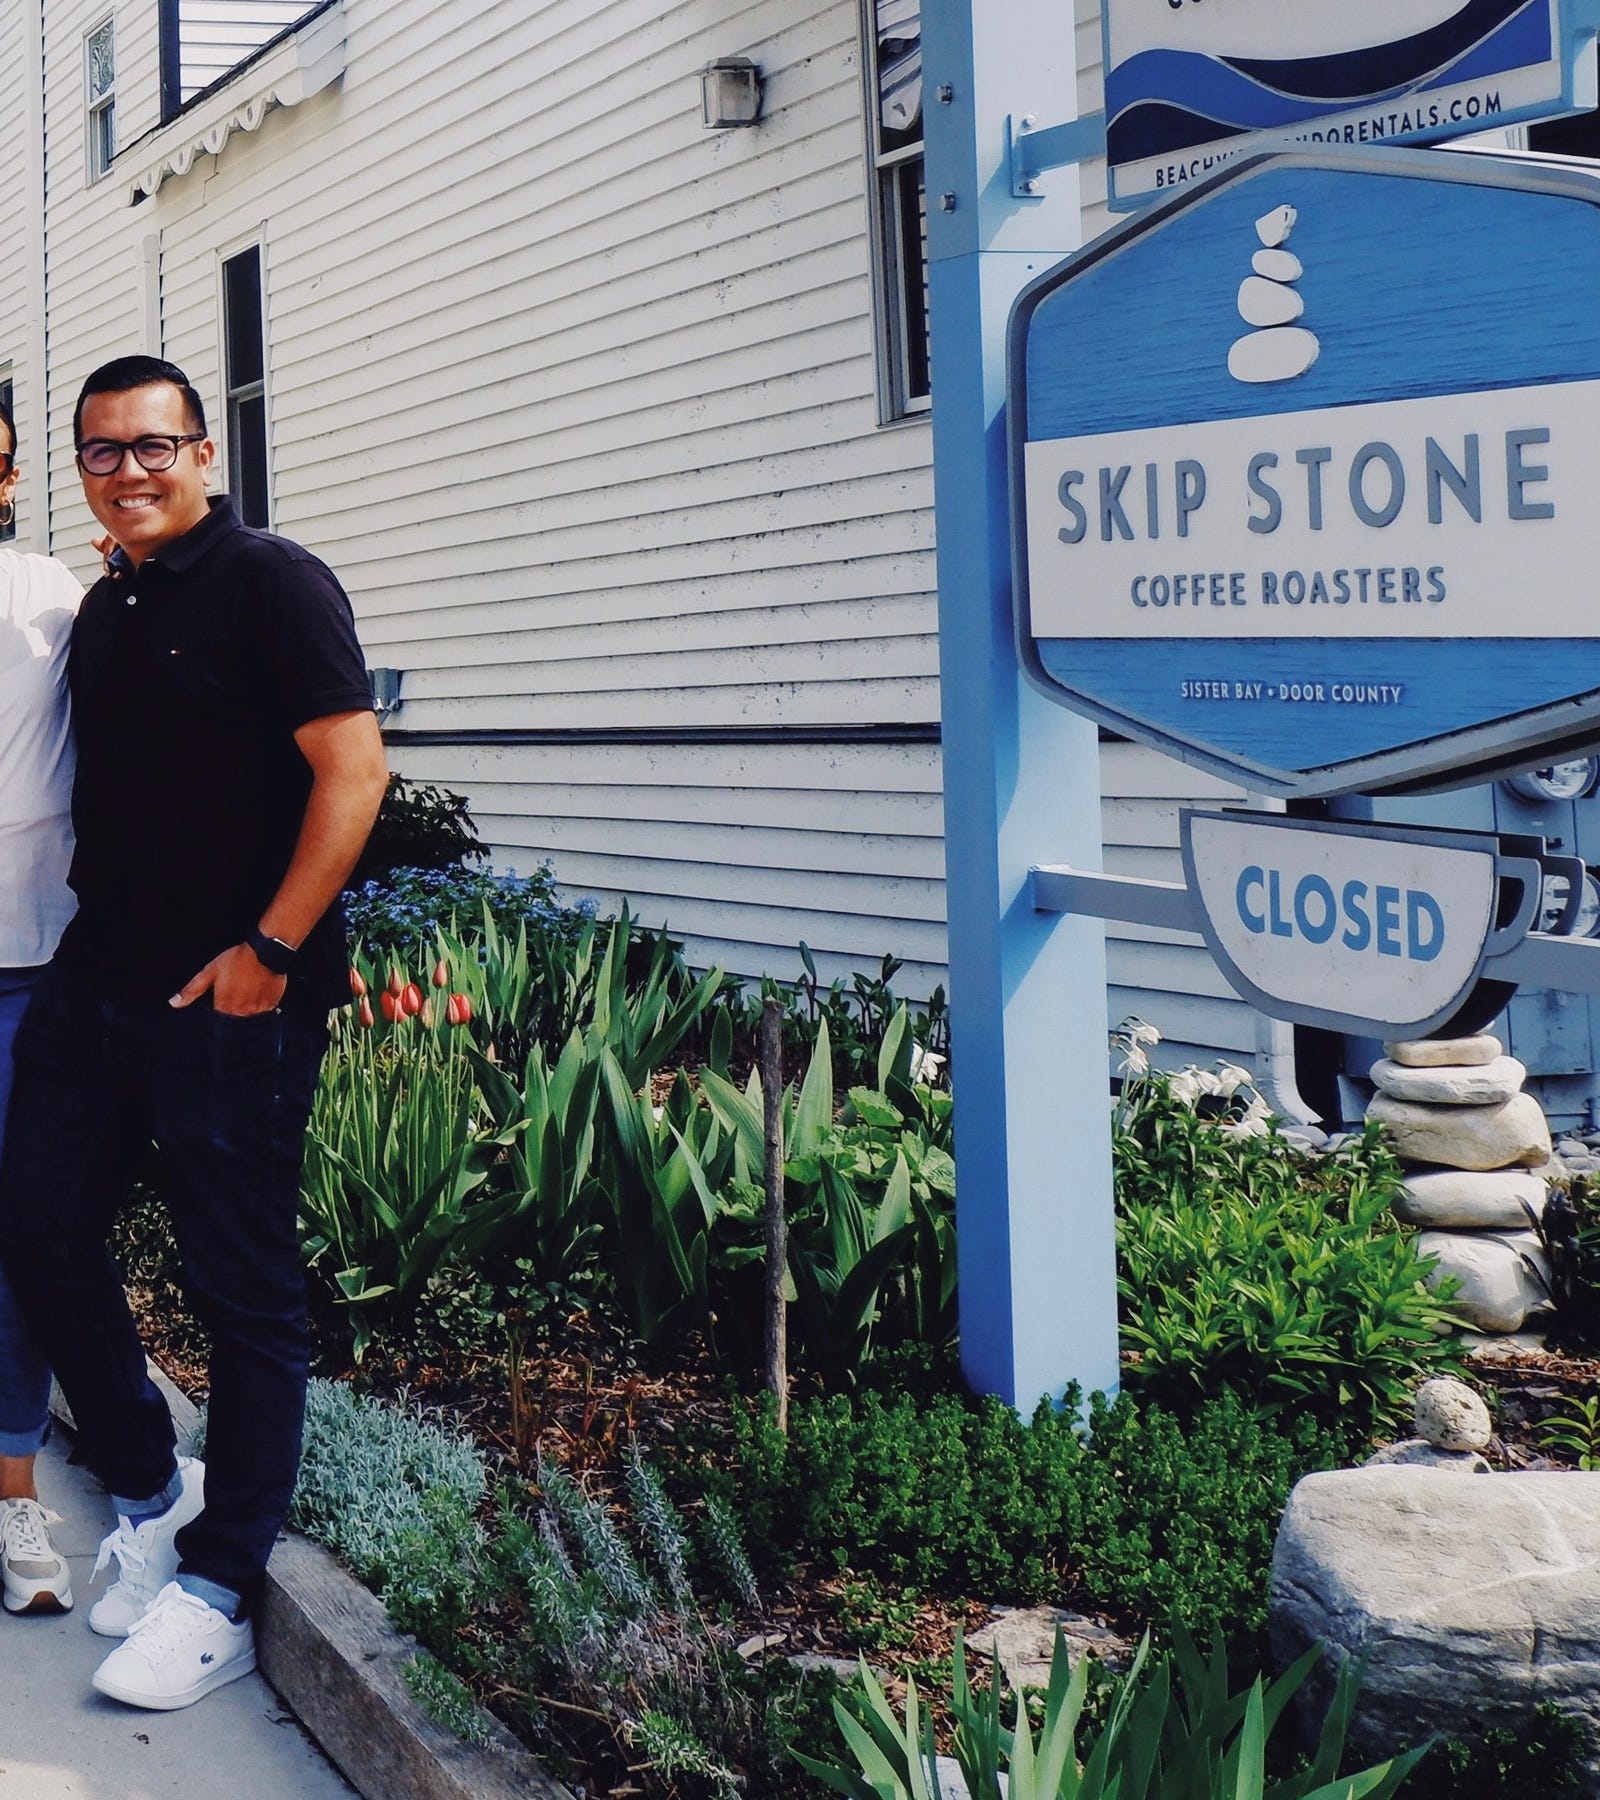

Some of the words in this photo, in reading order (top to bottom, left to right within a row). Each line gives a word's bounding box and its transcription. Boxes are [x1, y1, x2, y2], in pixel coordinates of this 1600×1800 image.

[1058, 459, 1207, 544] SKIP
[1247, 427, 1555, 534] STONE
[1130, 573, 1247, 607] COFFEE
[1261, 566, 1446, 604] ROASTERS
[1181, 681, 1229, 699] SISTER
[1235, 682, 1262, 700] BAY
[1279, 683, 1324, 702] DOOR
[1332, 684, 1401, 704] COUNTY
[1235, 865, 1445, 961] CLOSED
